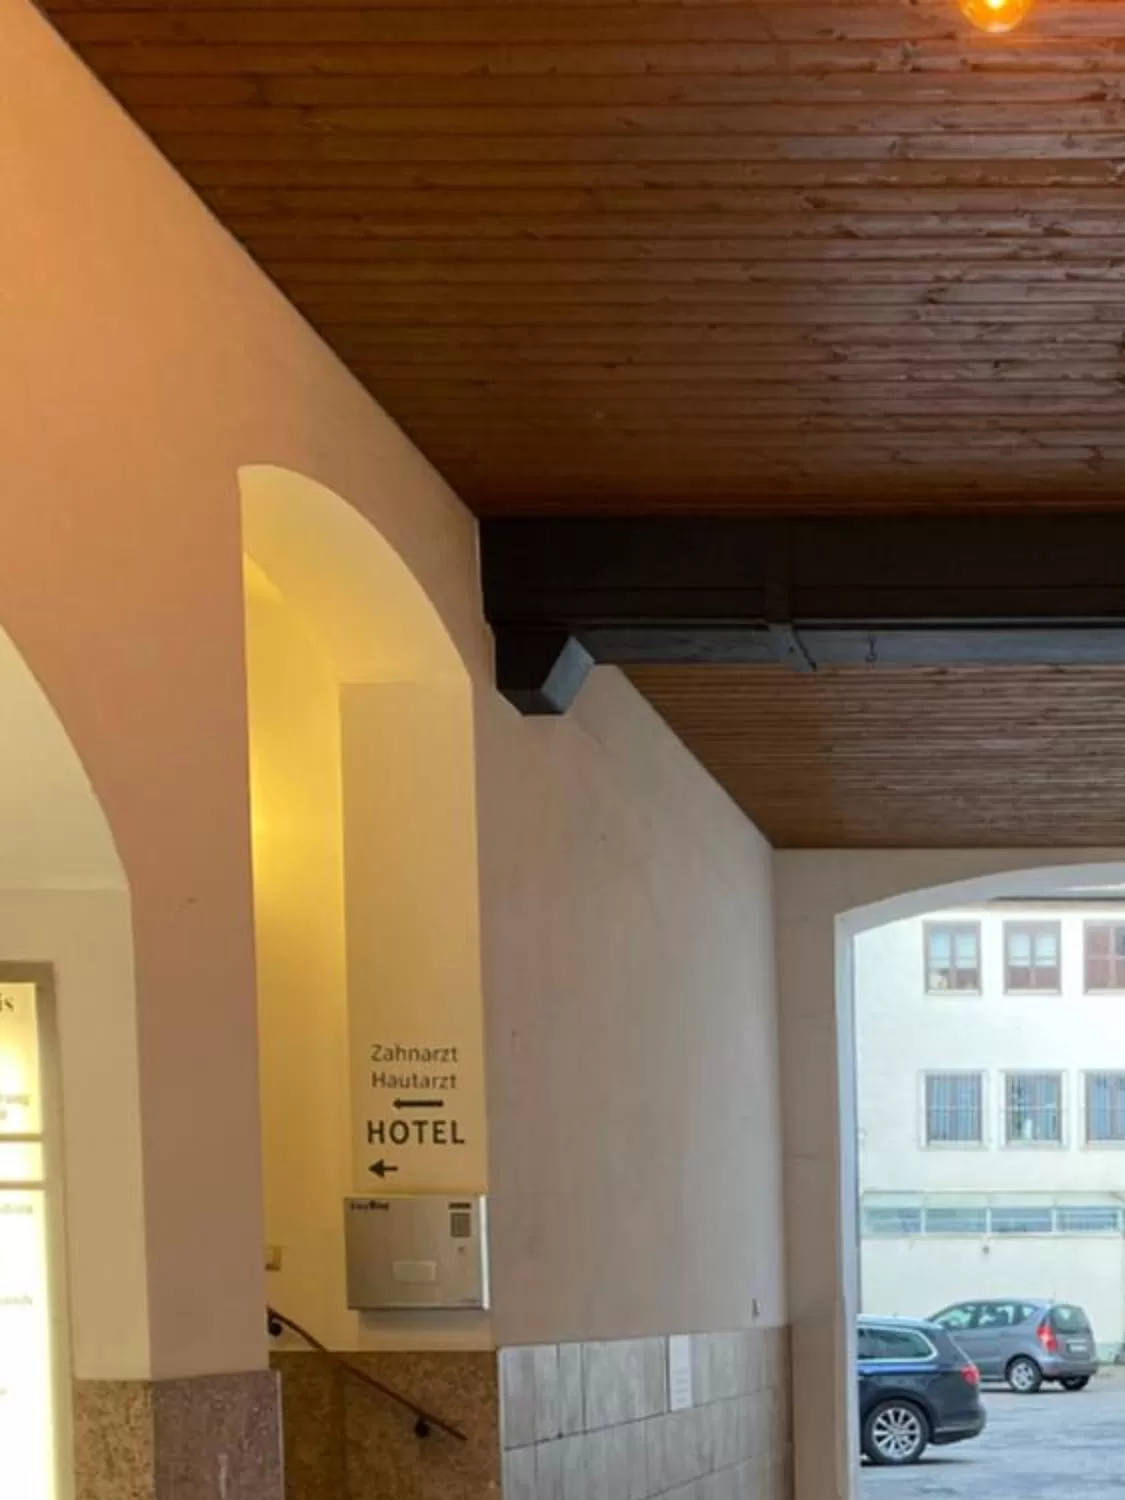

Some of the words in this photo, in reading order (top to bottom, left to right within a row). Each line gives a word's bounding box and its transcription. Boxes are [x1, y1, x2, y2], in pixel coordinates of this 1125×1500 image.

[370, 1044, 459, 1063] Zahnarzt
[371, 1071, 458, 1090] Hautarzt
[366, 1119, 466, 1145] HOTEL
